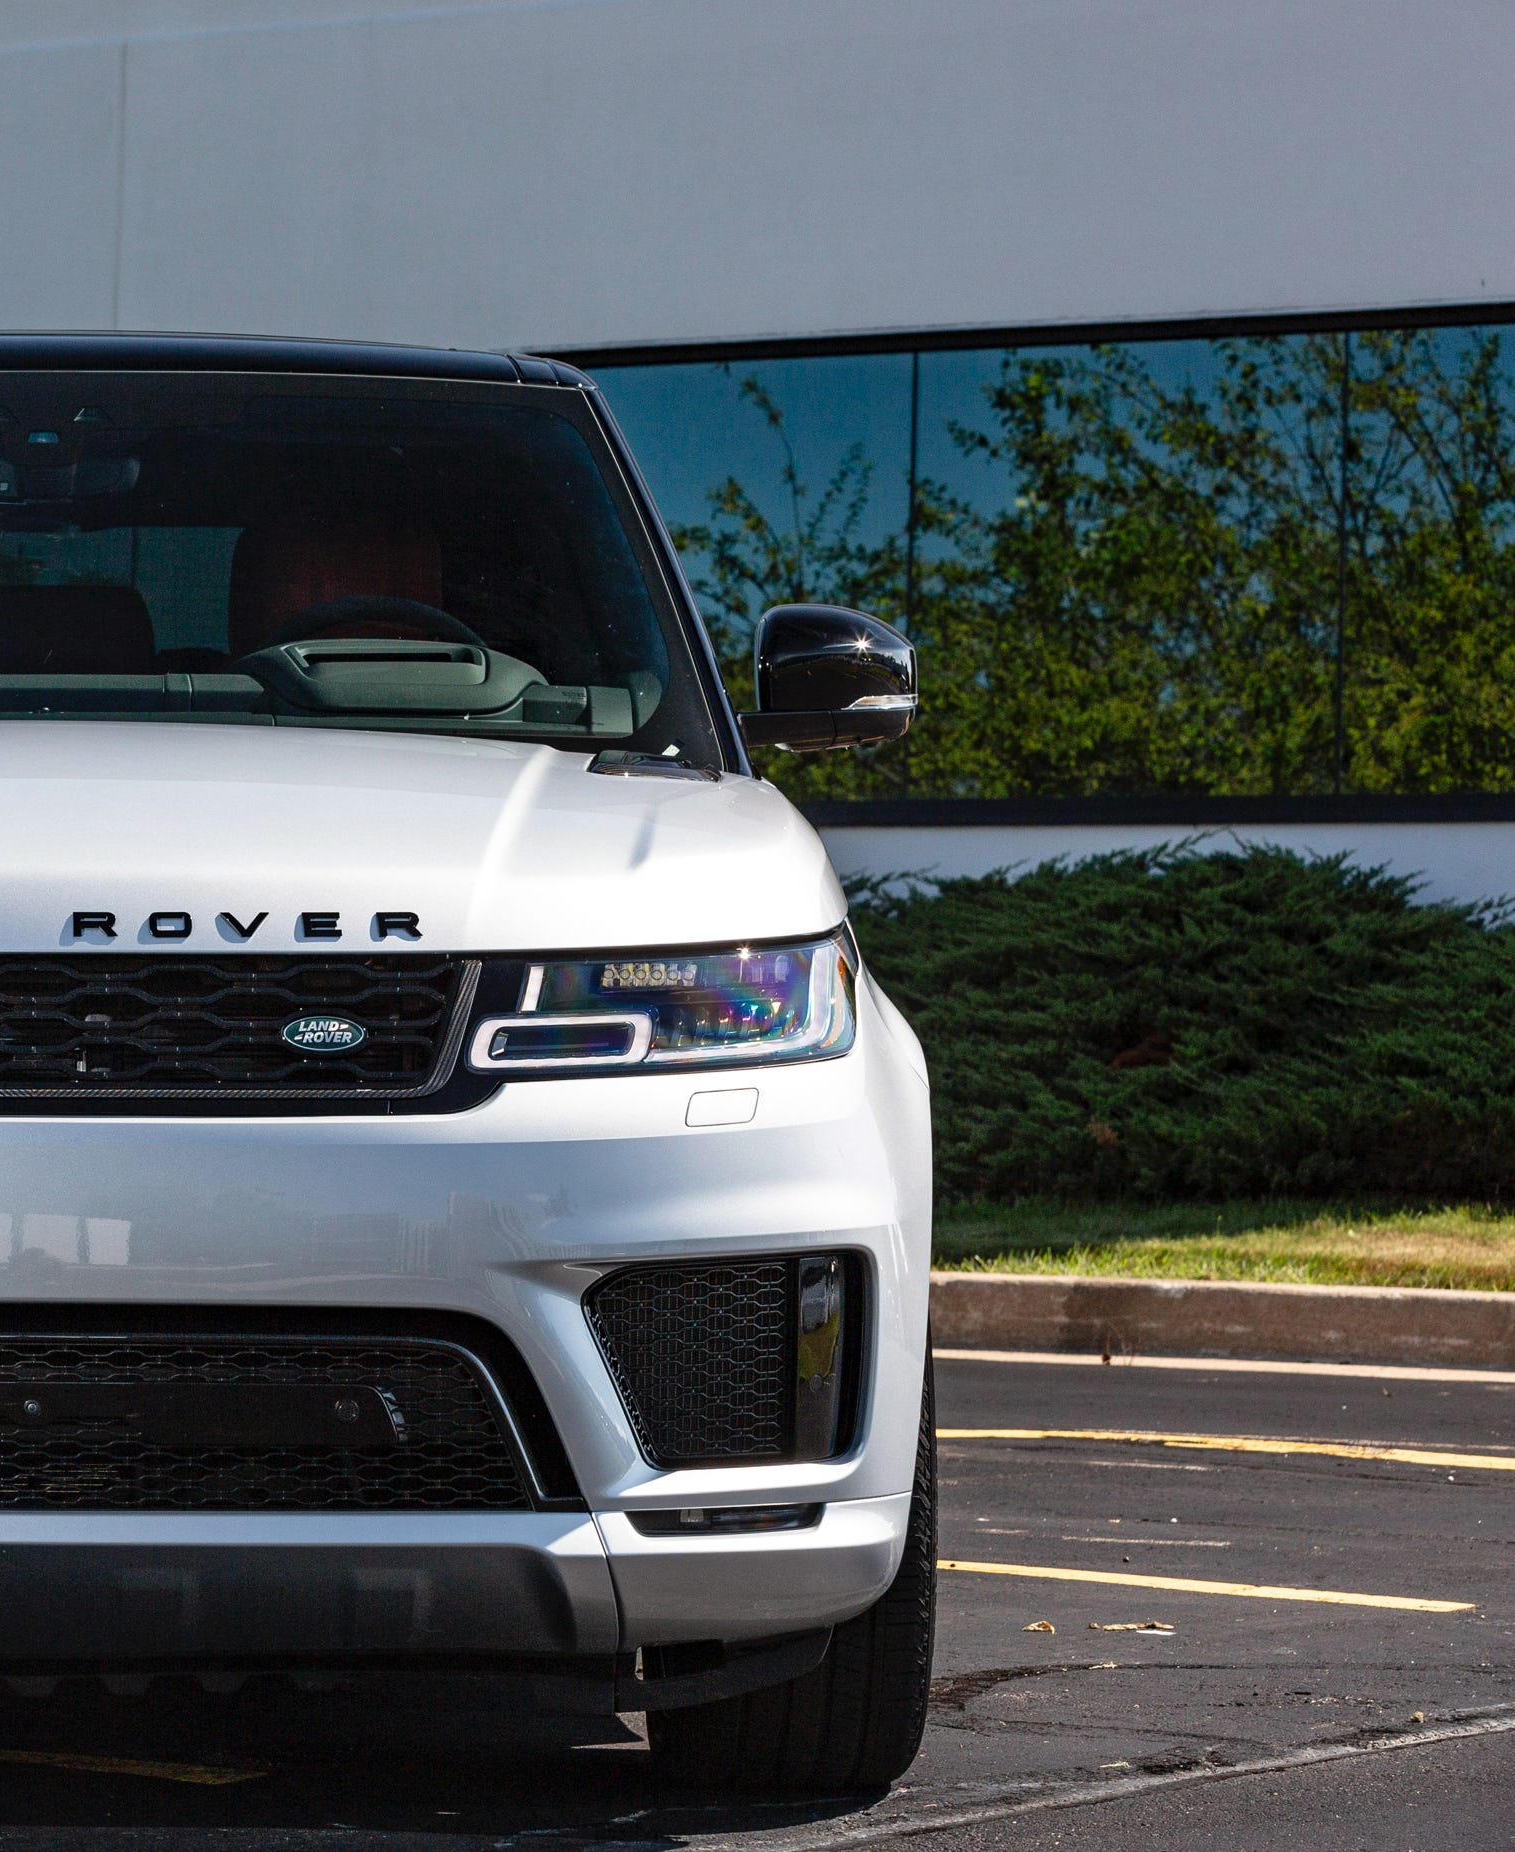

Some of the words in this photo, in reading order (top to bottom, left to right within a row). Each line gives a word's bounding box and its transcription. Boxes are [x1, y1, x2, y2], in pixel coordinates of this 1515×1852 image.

[72, 911, 423, 938] ROVER
[298, 1020, 340, 1032] LAND
[302, 1031, 353, 1044] ROVER
